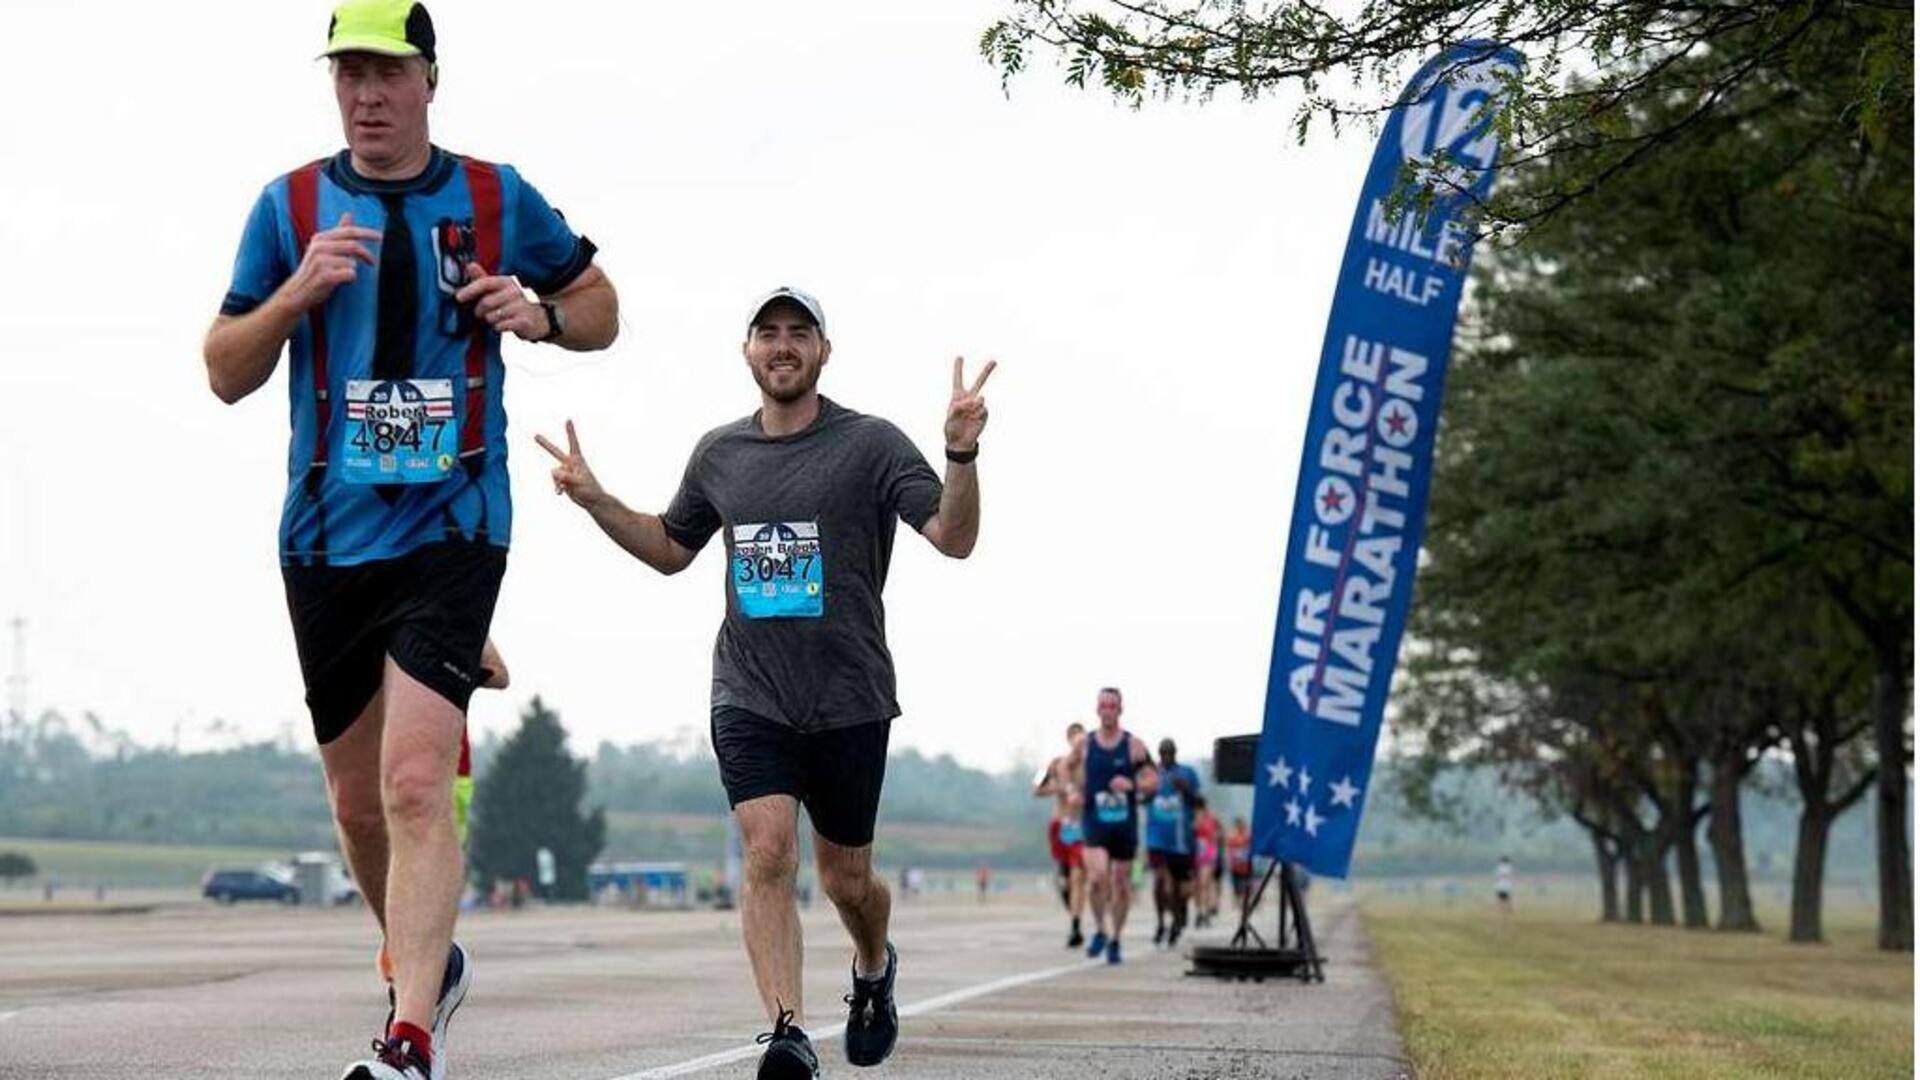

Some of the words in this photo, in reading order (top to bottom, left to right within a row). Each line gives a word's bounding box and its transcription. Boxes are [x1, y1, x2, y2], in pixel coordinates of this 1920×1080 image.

[1419, 81, 1492, 170] 12
[1365, 198, 1467, 267] MILE
[1364, 258, 1444, 306] HALF
[351, 420, 448, 453] 4847
[365, 404, 429, 420] Robert
[1304, 334, 1385, 569] FORCE
[739, 555, 815, 582] 3047
[1315, 346, 1429, 727] MARATHON
[1289, 586, 1330, 712] AIR
